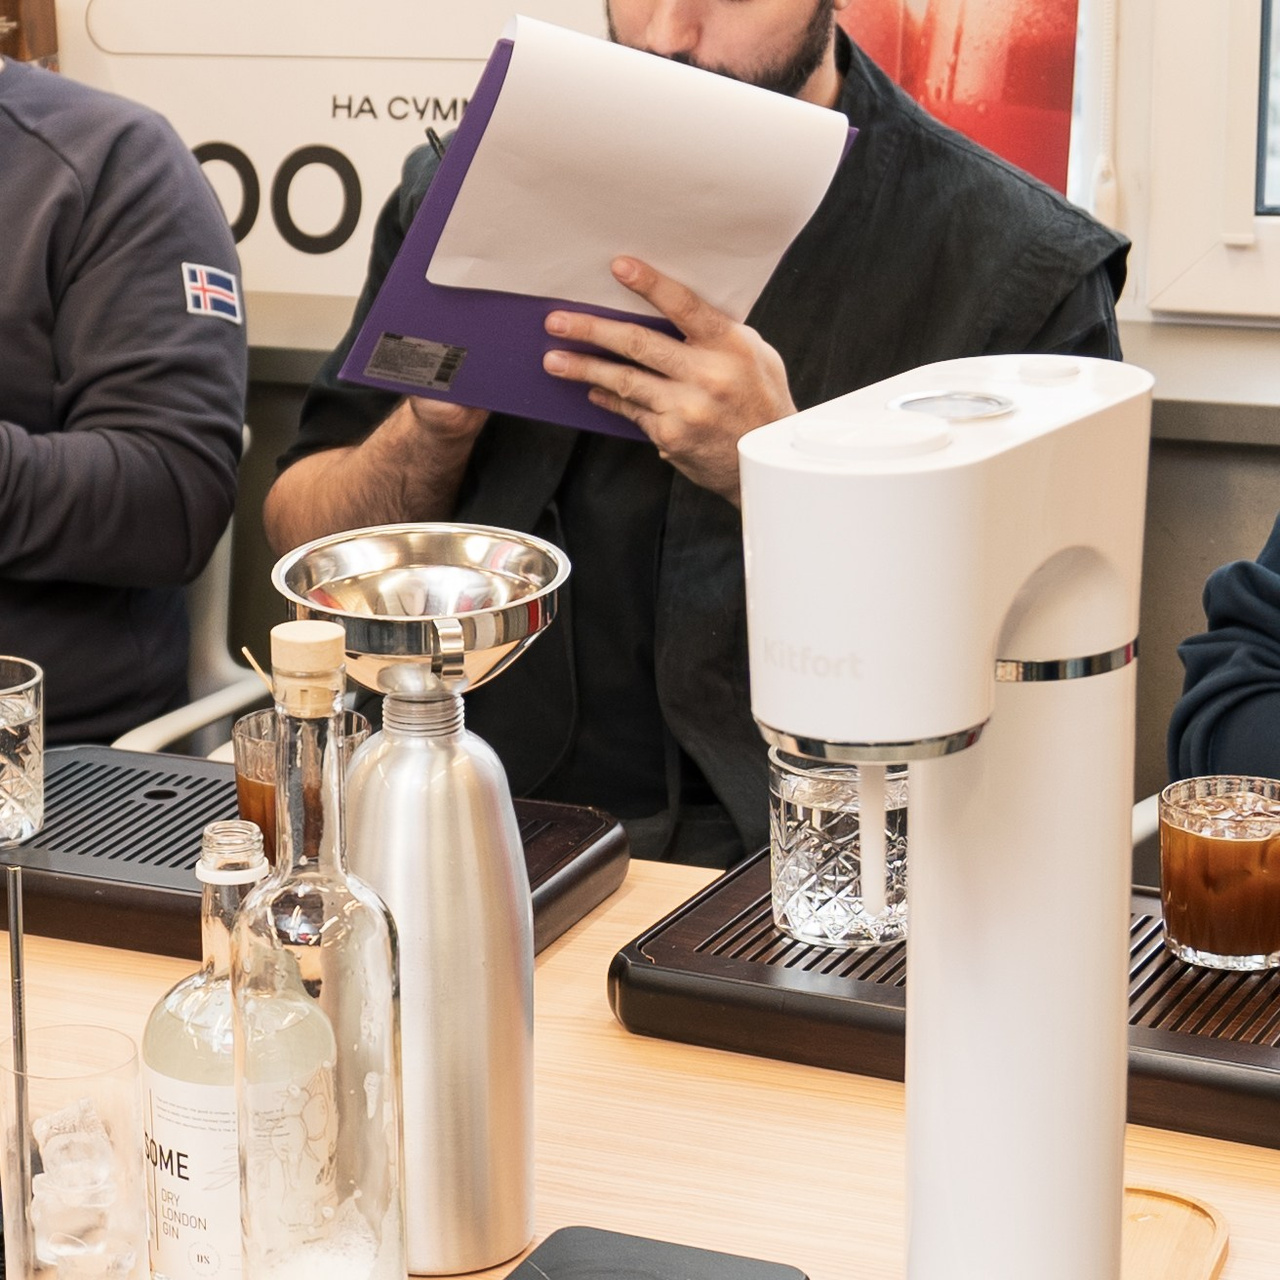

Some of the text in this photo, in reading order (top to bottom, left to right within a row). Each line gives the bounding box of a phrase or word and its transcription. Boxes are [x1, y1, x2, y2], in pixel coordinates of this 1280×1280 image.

[331, 94, 379, 120] НА
[161, 1188, 180, 1207] DRY
[161, 1206, 207, 1231] LONDON
[162, 1222, 180, 1240] GIN
